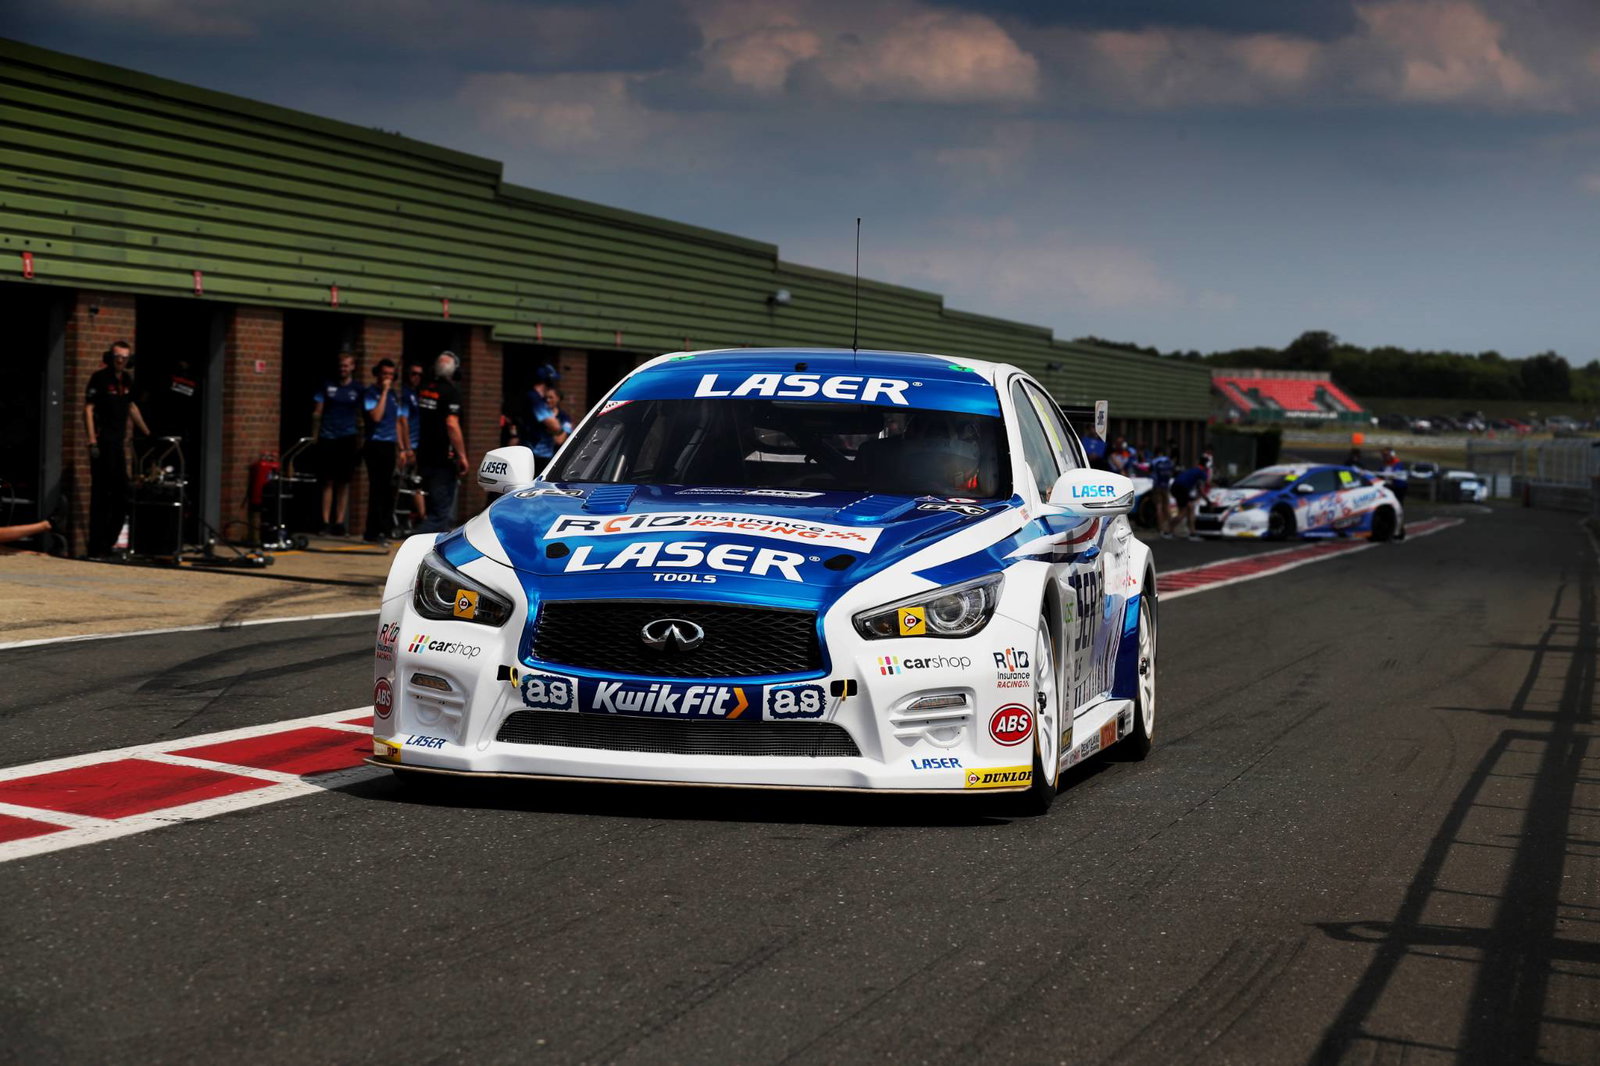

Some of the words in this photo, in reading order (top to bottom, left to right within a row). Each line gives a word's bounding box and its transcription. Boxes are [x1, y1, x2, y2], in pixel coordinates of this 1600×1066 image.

[694, 373, 909, 405] LASER
[481, 462, 507, 475] LASER
[1072, 485, 1116, 498] LASER
[689, 519, 820, 539] RACING
[564, 541, 805, 582] LASER
[652, 573, 717, 583] TOOLS
[428, 639, 481, 660] carshop
[903, 655, 971, 670] carshop
[997, 671, 1030, 680] Insurance
[525, 678, 569, 704] as
[996, 680, 1023, 689] RACING
[376, 688, 391, 707] ABS
[773, 688, 821, 714] as
[996, 714, 1028, 733] ABS
[405, 734, 447, 749] LASER
[911, 757, 963, 770] LASER
